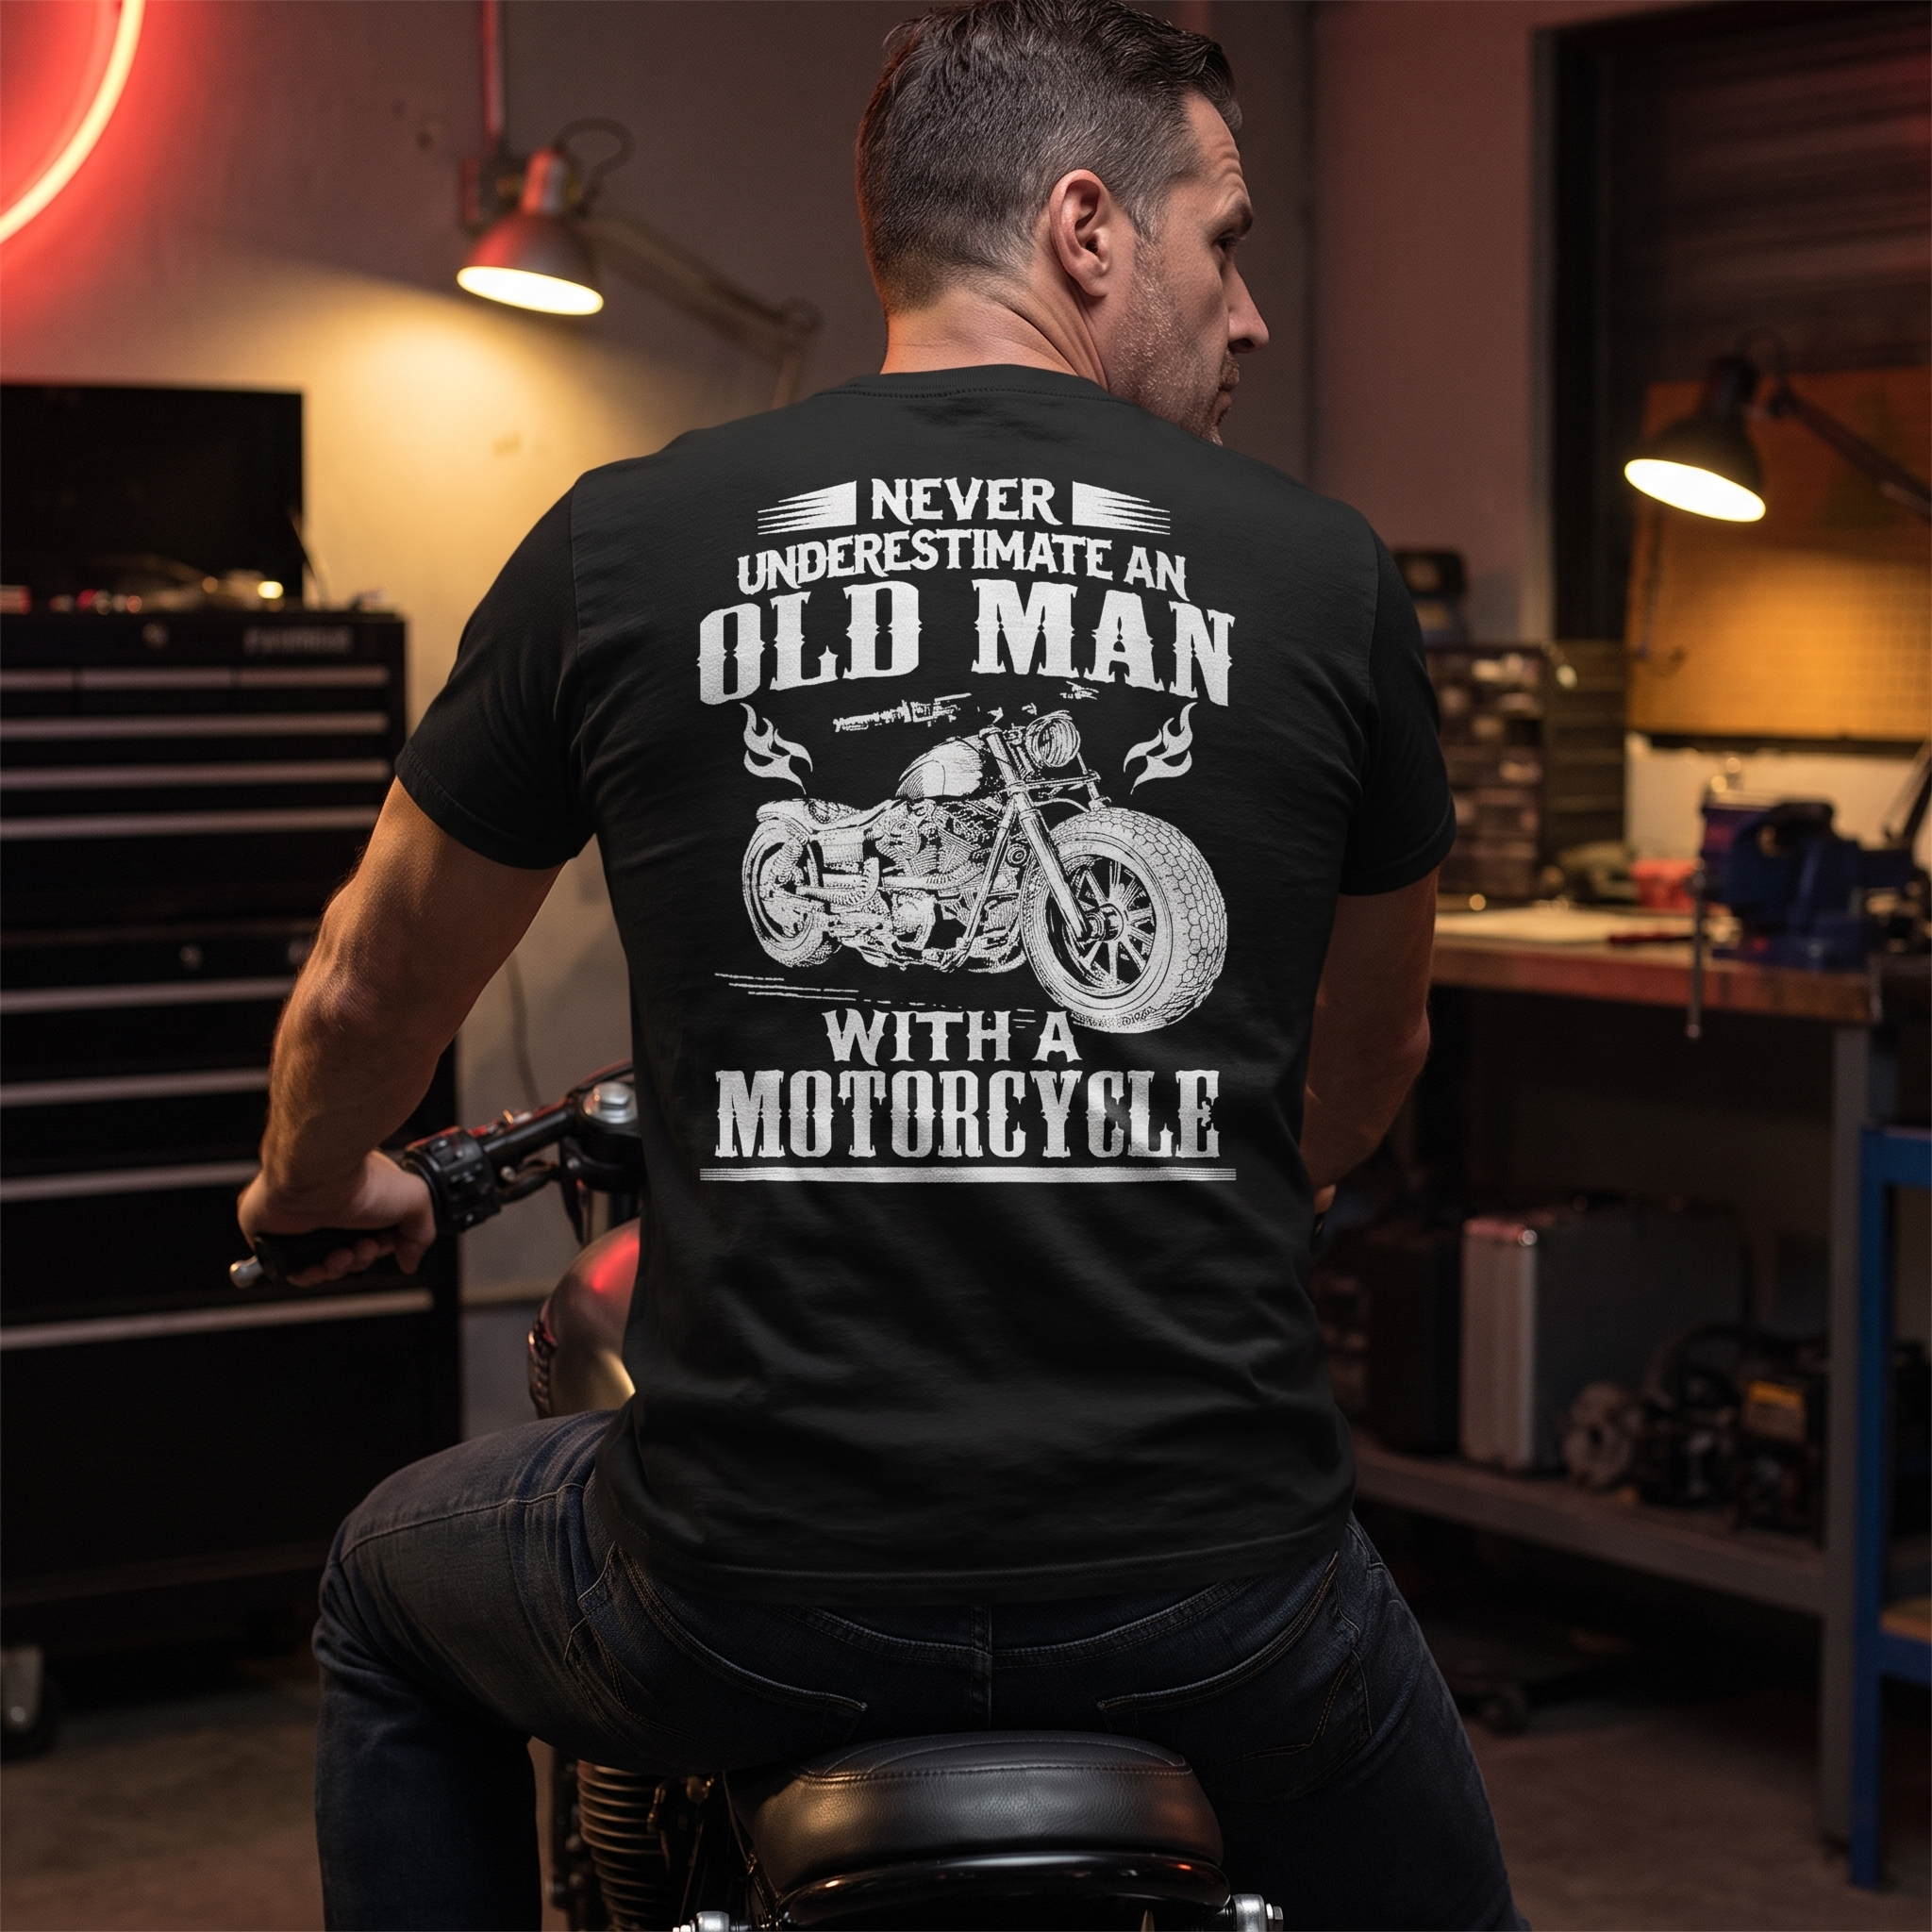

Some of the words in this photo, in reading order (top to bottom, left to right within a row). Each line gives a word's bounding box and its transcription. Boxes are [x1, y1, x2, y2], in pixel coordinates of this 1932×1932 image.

[871, 477, 1064, 525] NEVER
[737, 529, 1114, 594] UNDERESTIMATE
[1124, 546, 1191, 601] AN
[696, 580, 922, 706] OLD
[971, 578, 1235, 707] MAN
[822, 1008, 1011, 1066] WITH
[1032, 1011, 1083, 1062] A
[714, 1069, 1221, 1158] MOTORCYCLE
